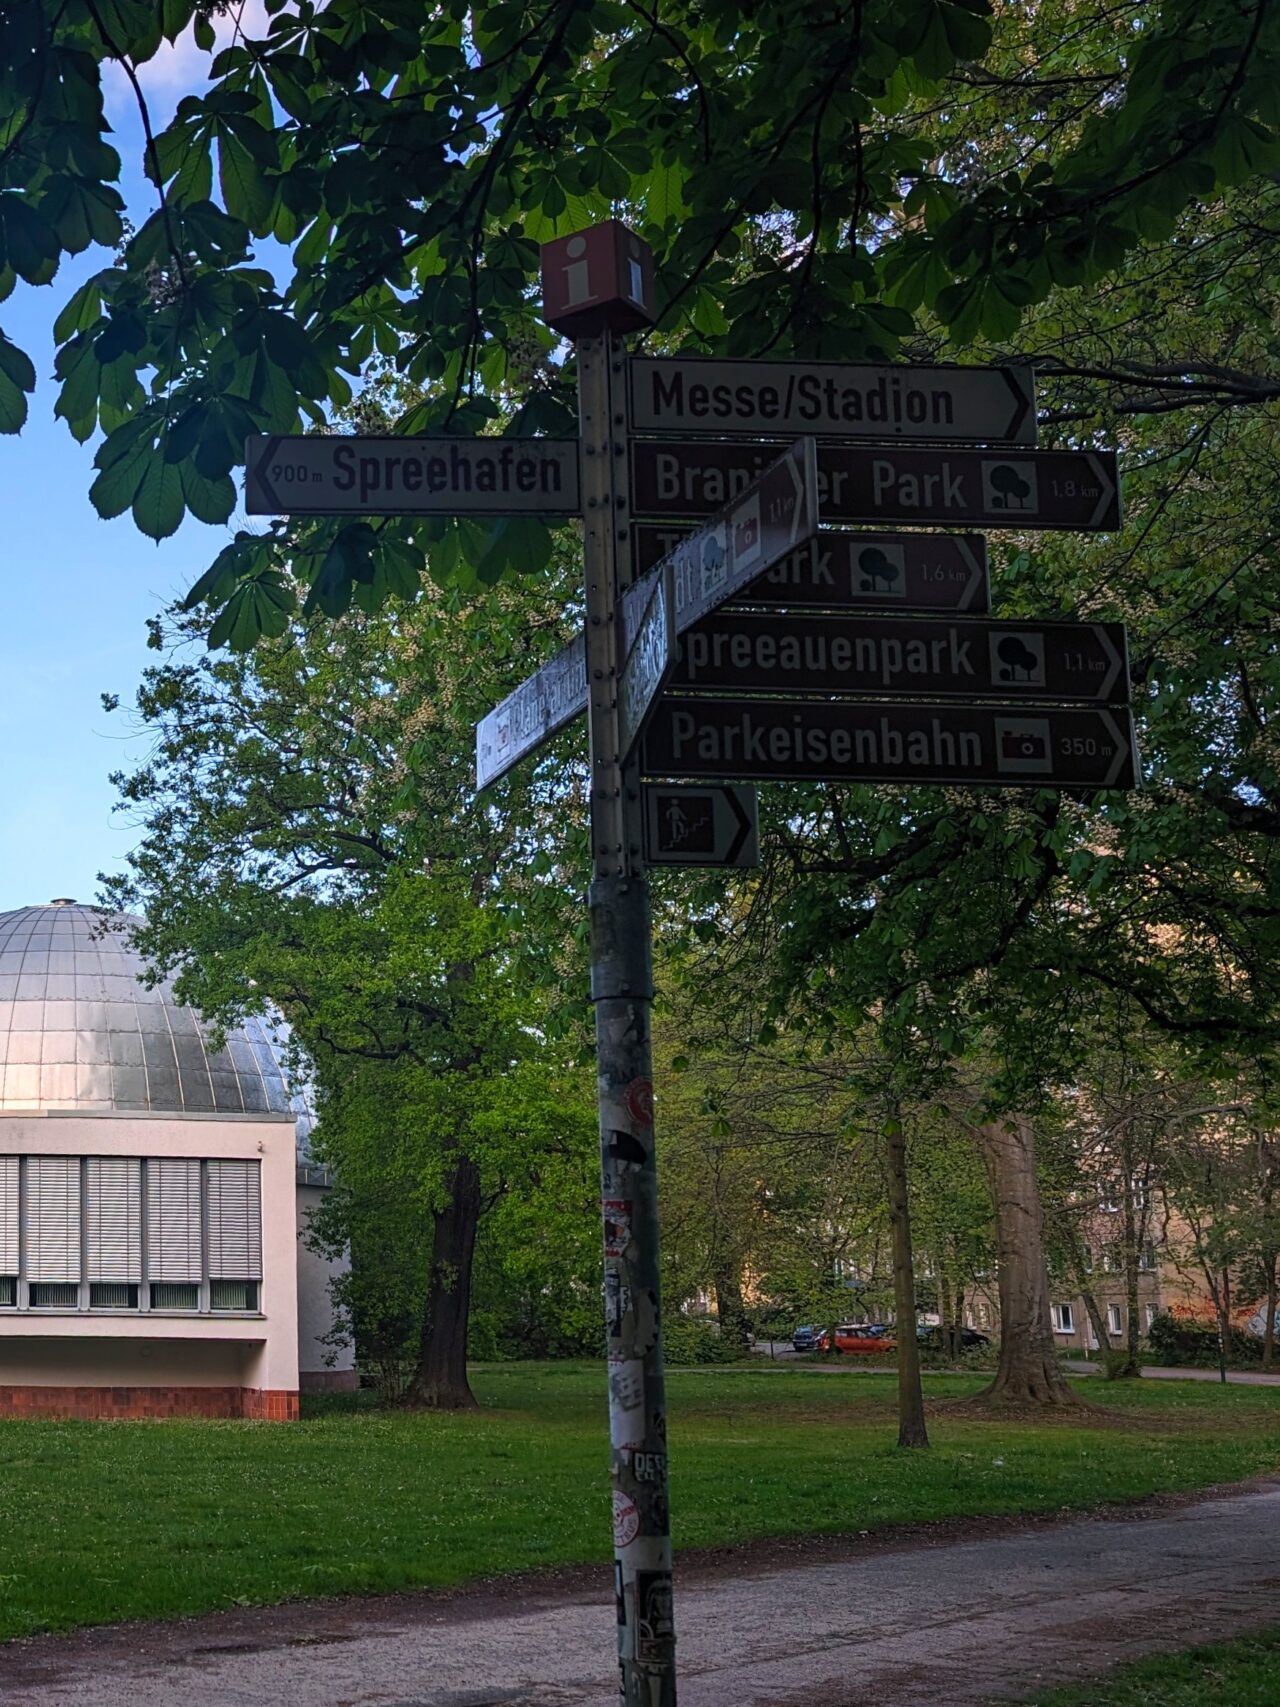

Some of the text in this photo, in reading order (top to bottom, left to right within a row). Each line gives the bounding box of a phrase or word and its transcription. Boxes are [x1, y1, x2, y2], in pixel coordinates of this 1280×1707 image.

[651, 370, 954, 425] Messe/Stadion
[271, 464, 308, 483] 900
[332, 444, 562, 503] Spreehafen
[872, 459, 968, 509] Park
[1080, 486, 1099, 498] km
[949, 570, 966, 582] km
[676, 628, 976, 684] preeauenpark
[1087, 658, 1106, 672] km
[670, 711, 983, 767] Parkeisenbahn
[1060, 737, 1097, 756] 350
